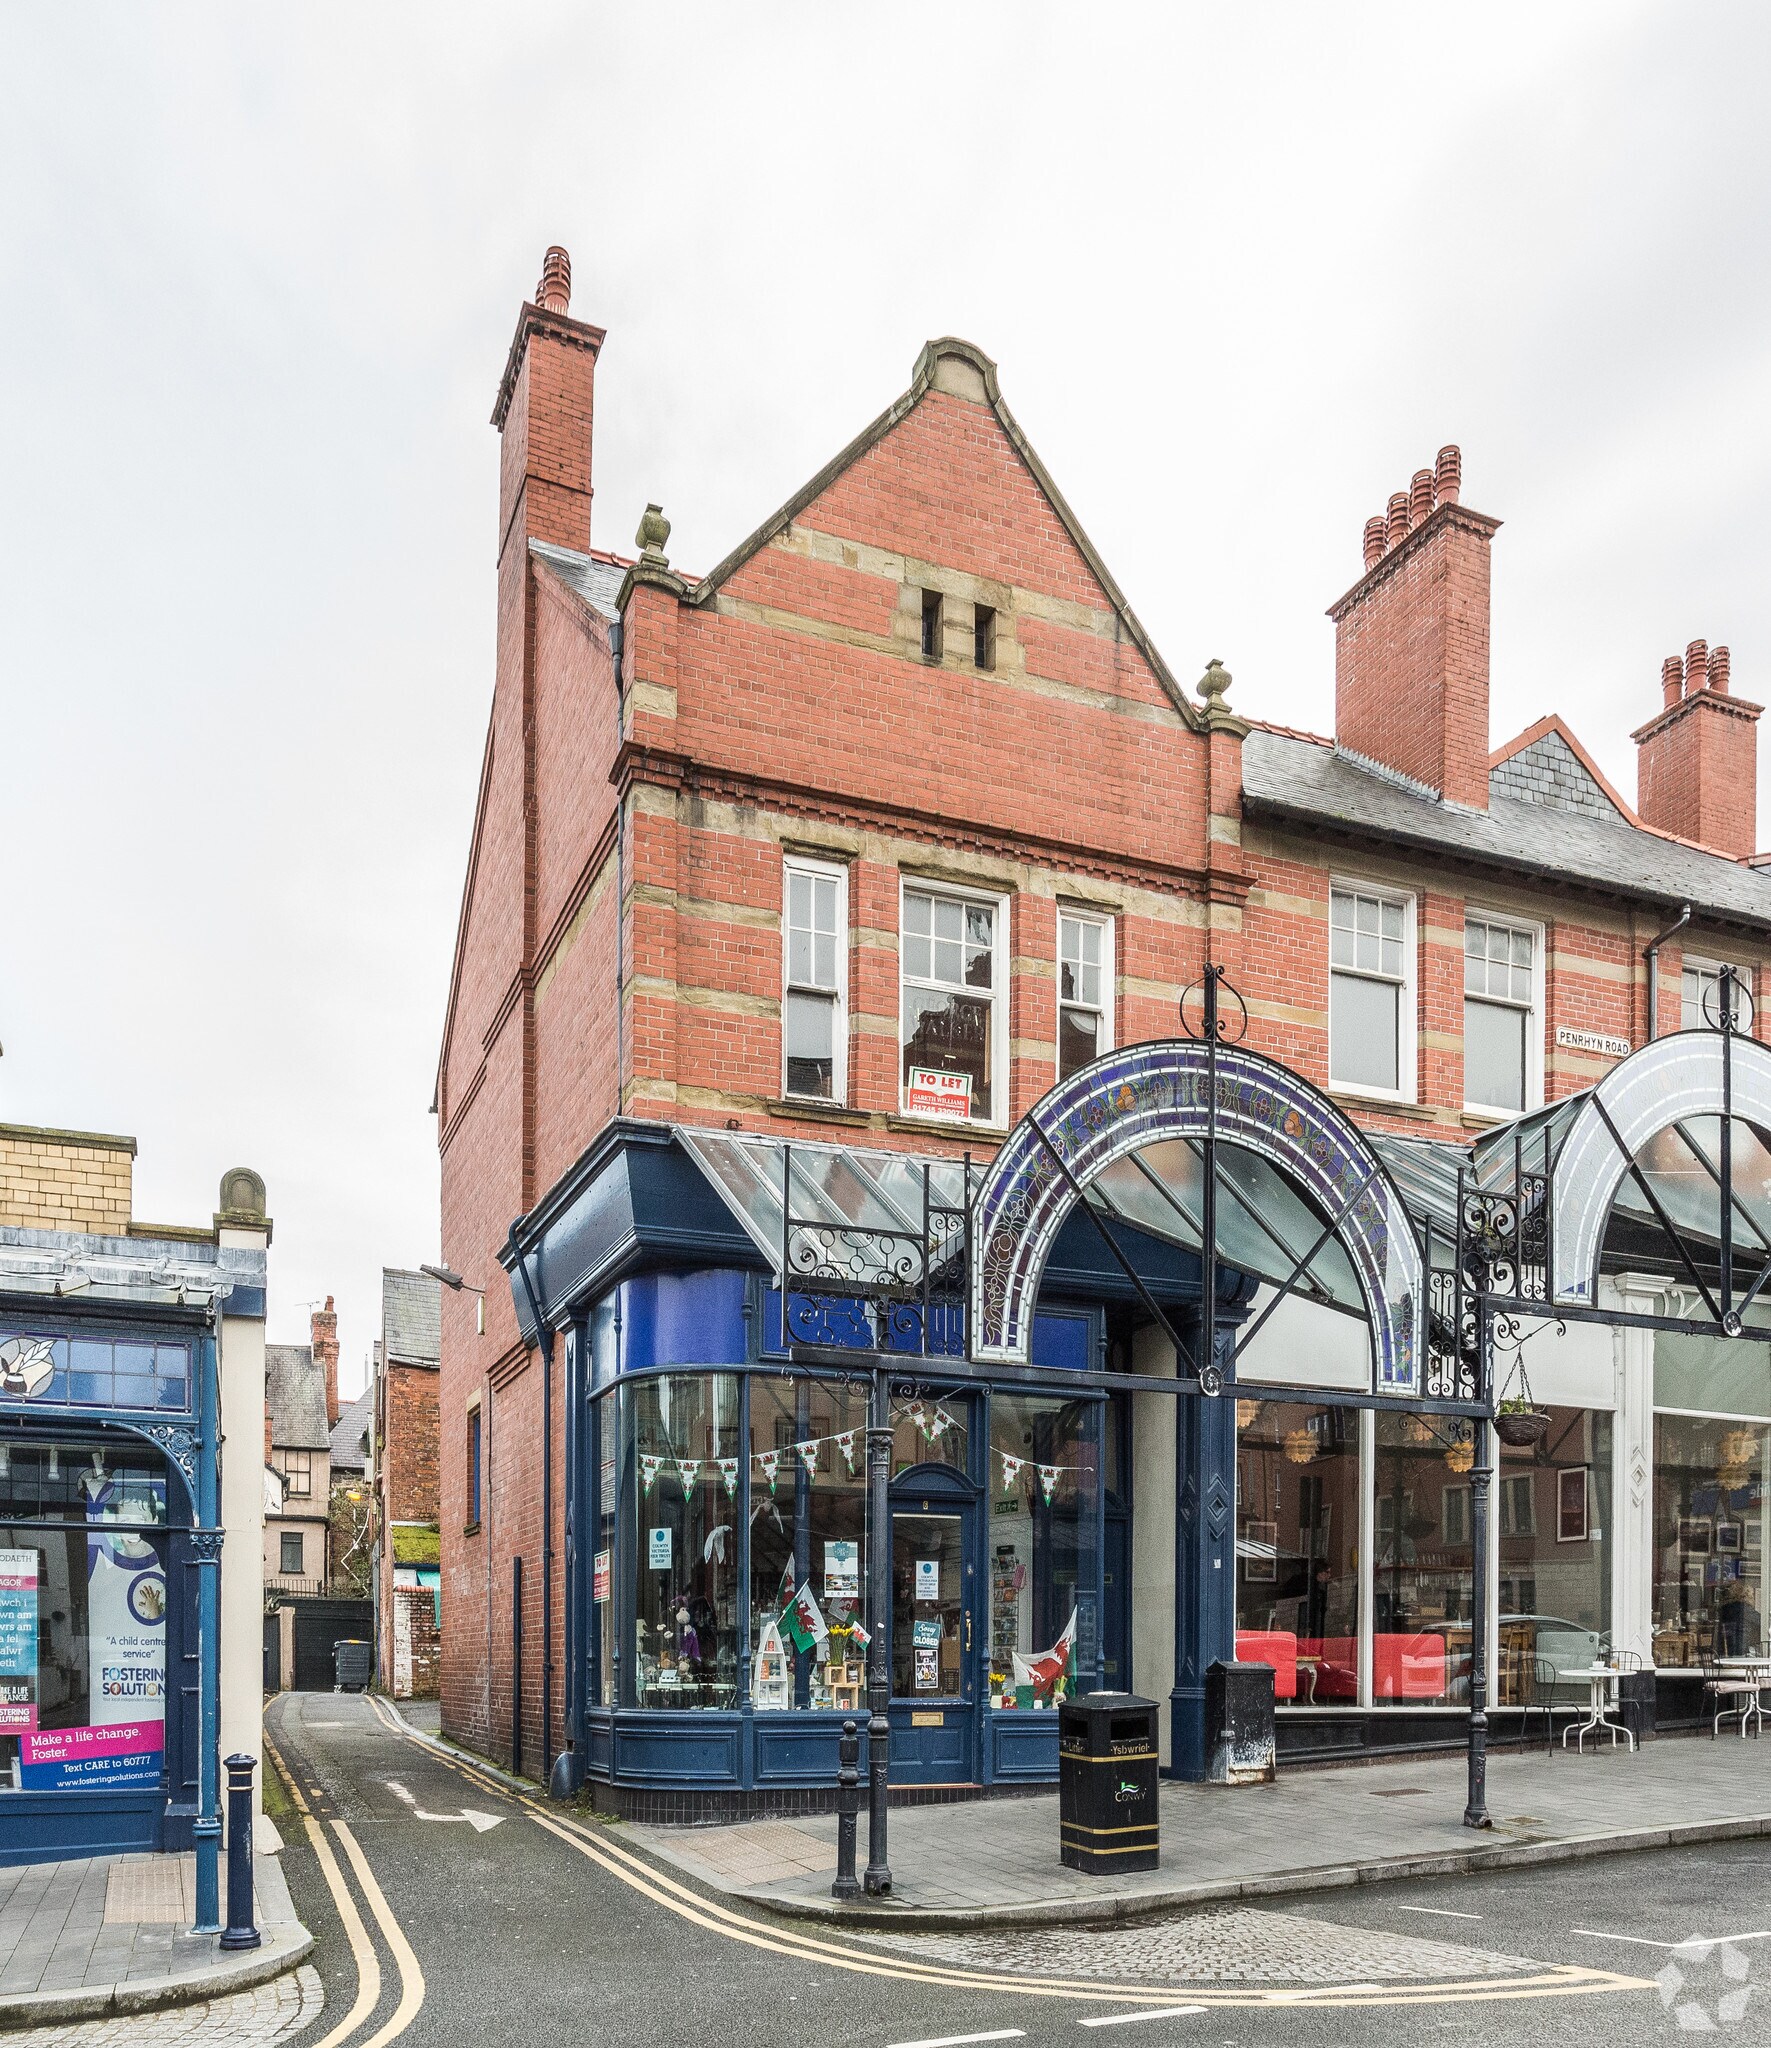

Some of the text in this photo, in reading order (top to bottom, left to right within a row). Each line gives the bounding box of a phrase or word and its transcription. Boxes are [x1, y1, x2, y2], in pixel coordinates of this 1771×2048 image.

[1560, 1031, 1629, 1055] PENRHYN ROAD
[919, 1073, 962, 1089] TO LET
[912, 1093, 936, 1102] GARETH
[937, 1096, 966, 1106] WILLIAMS
[17, 1611, 32, 1619] am
[17, 1623, 32, 1631] am
[918, 1623, 936, 1636] Sorry
[6, 1634, 19, 1643] fel
[118, 1636, 138, 1646] child
[914, 1635, 939, 1646] CLOSED
[102, 1667, 166, 1681] FOSTERIN
[17, 1686, 29, 1694] LIFE
[30, 1727, 142, 1747] Make a life change.
[32, 1747, 68, 1760] Foster.
[1112, 1743, 1148, 1755] Ysbwriel
[62, 1755, 151, 1773] Text CARE to 60777
[56, 1770, 160, 1787] www.fosteringsolutions.com
